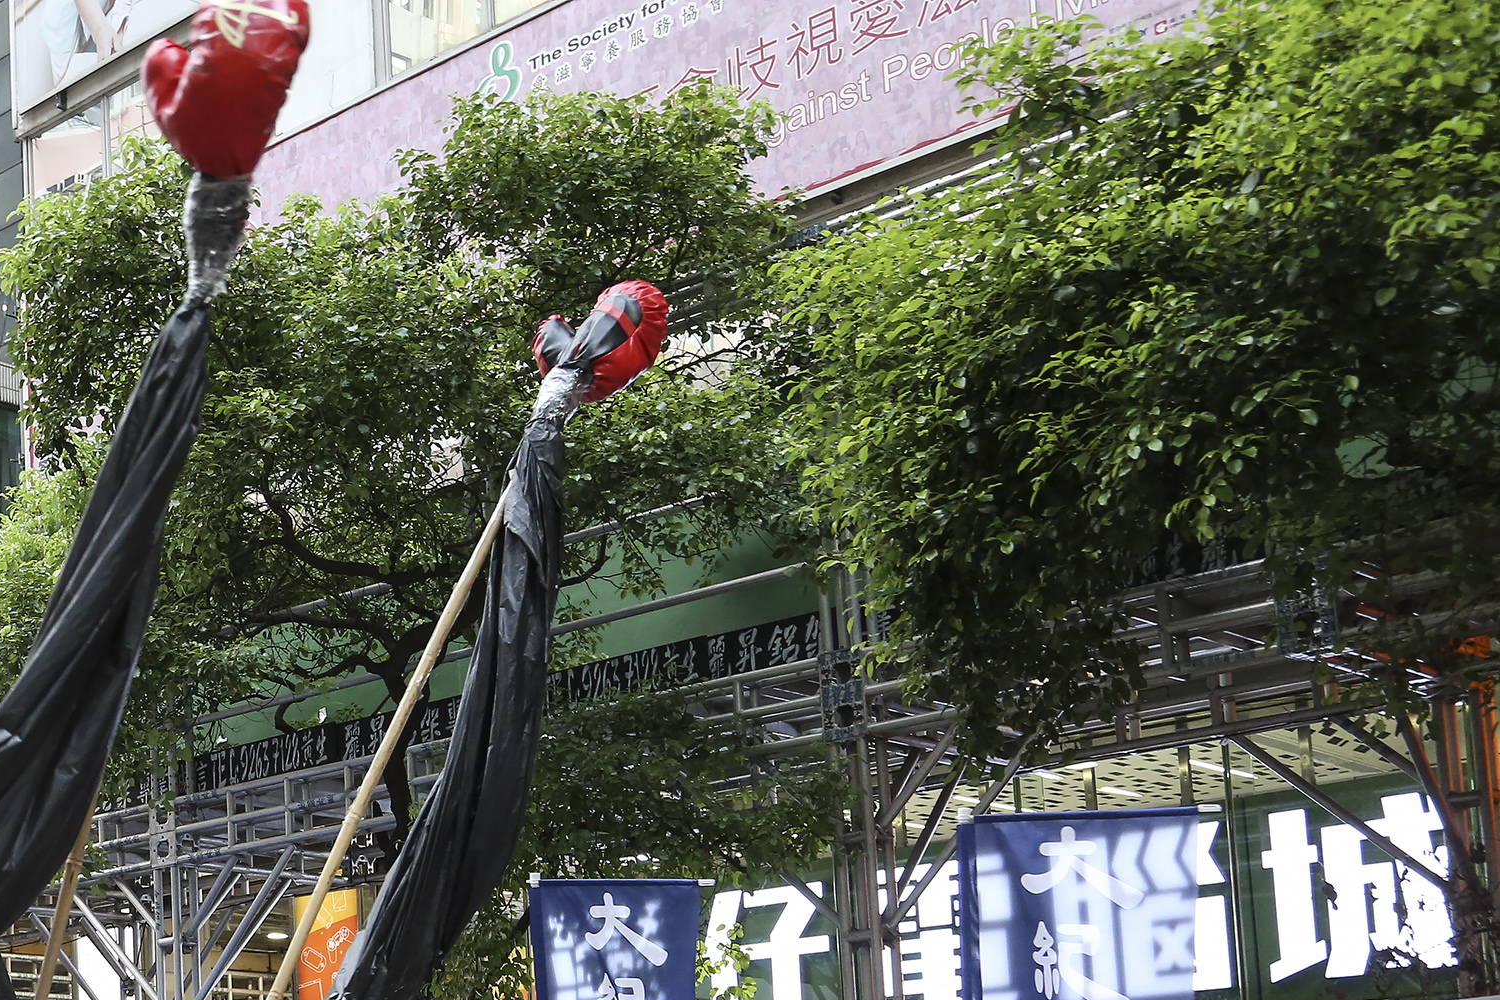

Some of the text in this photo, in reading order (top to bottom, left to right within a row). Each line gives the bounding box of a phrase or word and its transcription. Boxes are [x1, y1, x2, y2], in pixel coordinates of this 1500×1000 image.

[529, 47, 562, 71] The
[567, 12, 635, 52] Society
[762, 70, 872, 148] gainst
